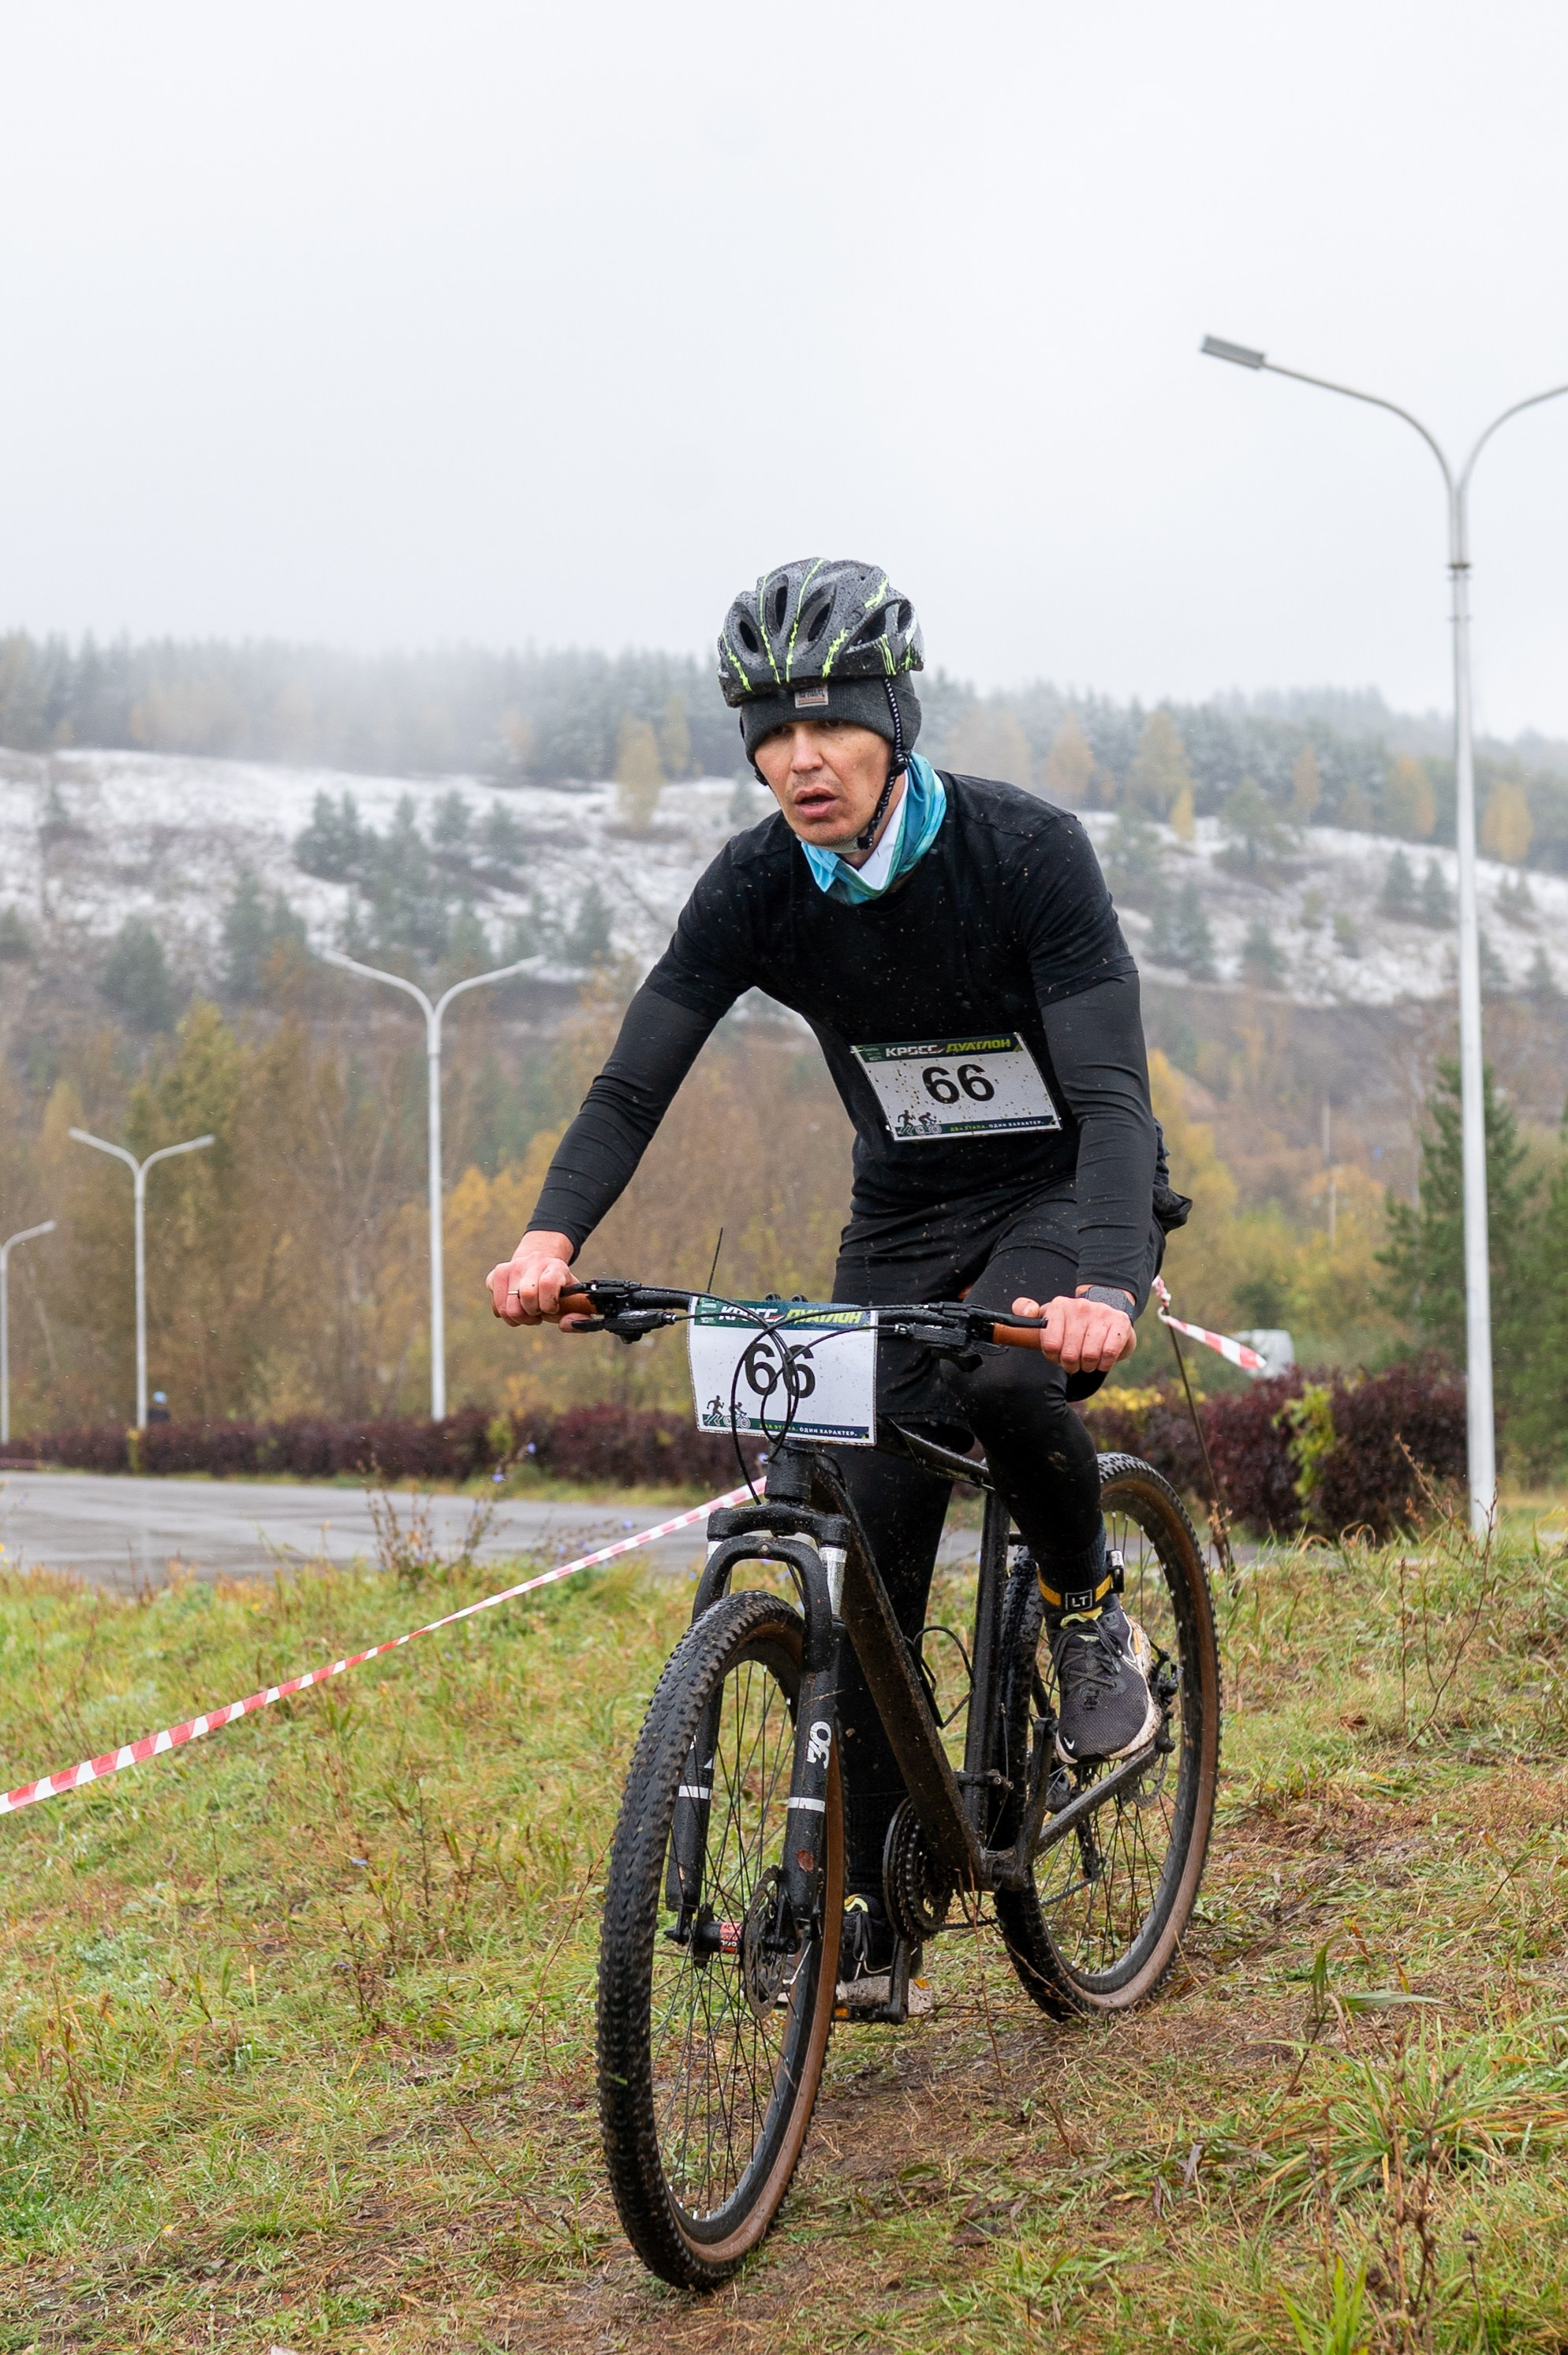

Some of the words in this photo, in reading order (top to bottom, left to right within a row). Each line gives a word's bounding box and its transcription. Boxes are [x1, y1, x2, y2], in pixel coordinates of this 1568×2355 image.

[885, 1045, 944, 1057] КРОСС
[946, 1038, 1011, 1054] ДУАТЛОН
[922, 1063, 995, 1105] 66
[786, 1309, 862, 1325] ДУАТЛОН
[745, 1343, 816, 1399] 66
[1072, 1595, 1088, 1607] LT
